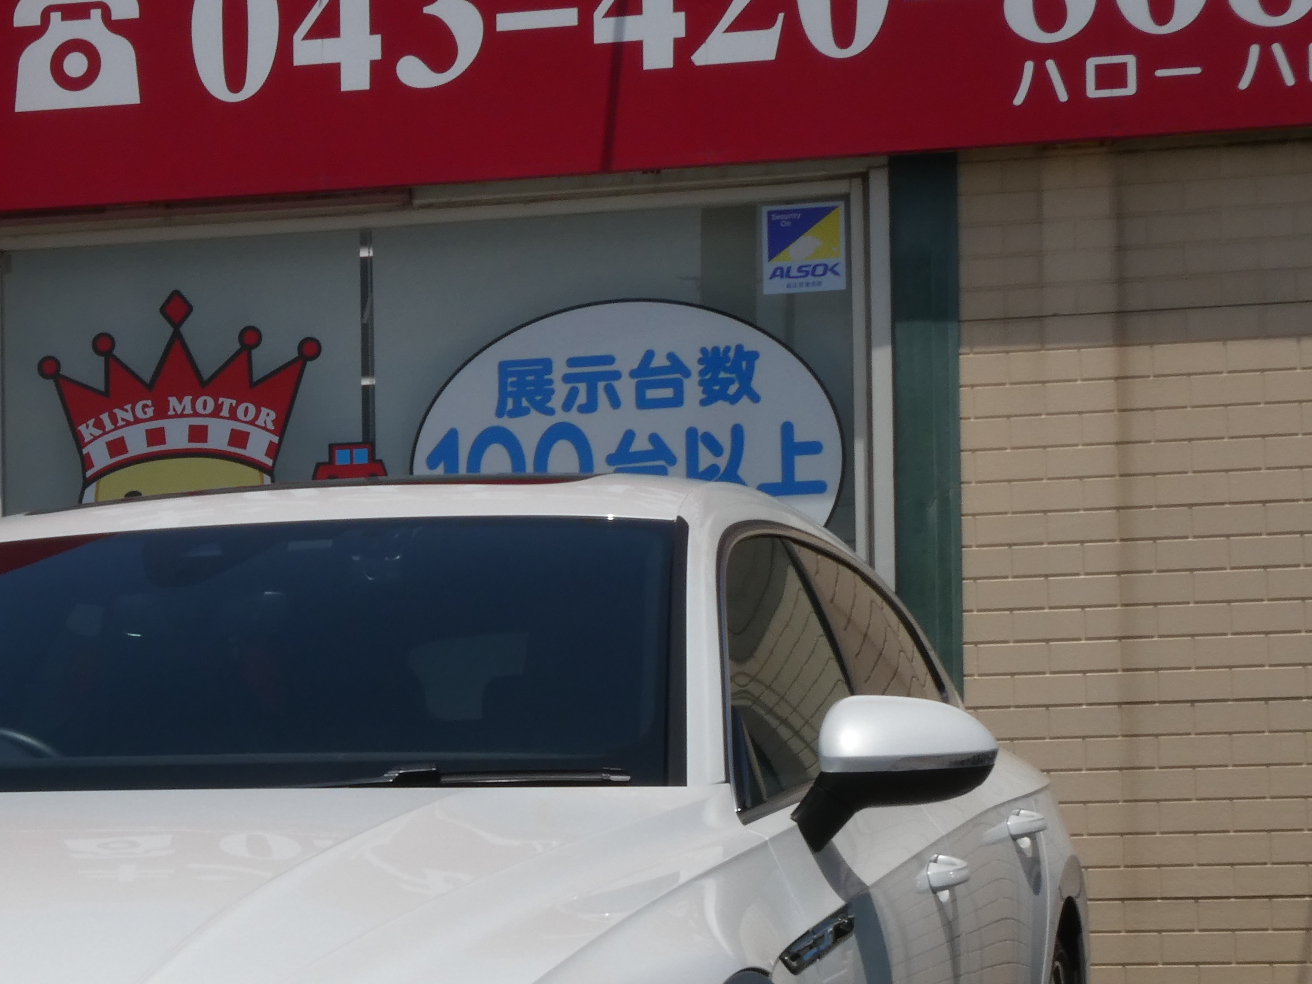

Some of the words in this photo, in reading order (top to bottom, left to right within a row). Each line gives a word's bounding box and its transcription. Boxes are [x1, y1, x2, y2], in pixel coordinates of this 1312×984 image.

[1013, 55, 1202, 106] ハロー
[1237, 43, 1312, 91] ハ
[769, 262, 841, 280] ALSOK
[496, 344, 760, 419] 展示台数
[78, 399, 156, 443] KING
[168, 395, 278, 430] MOTOR
